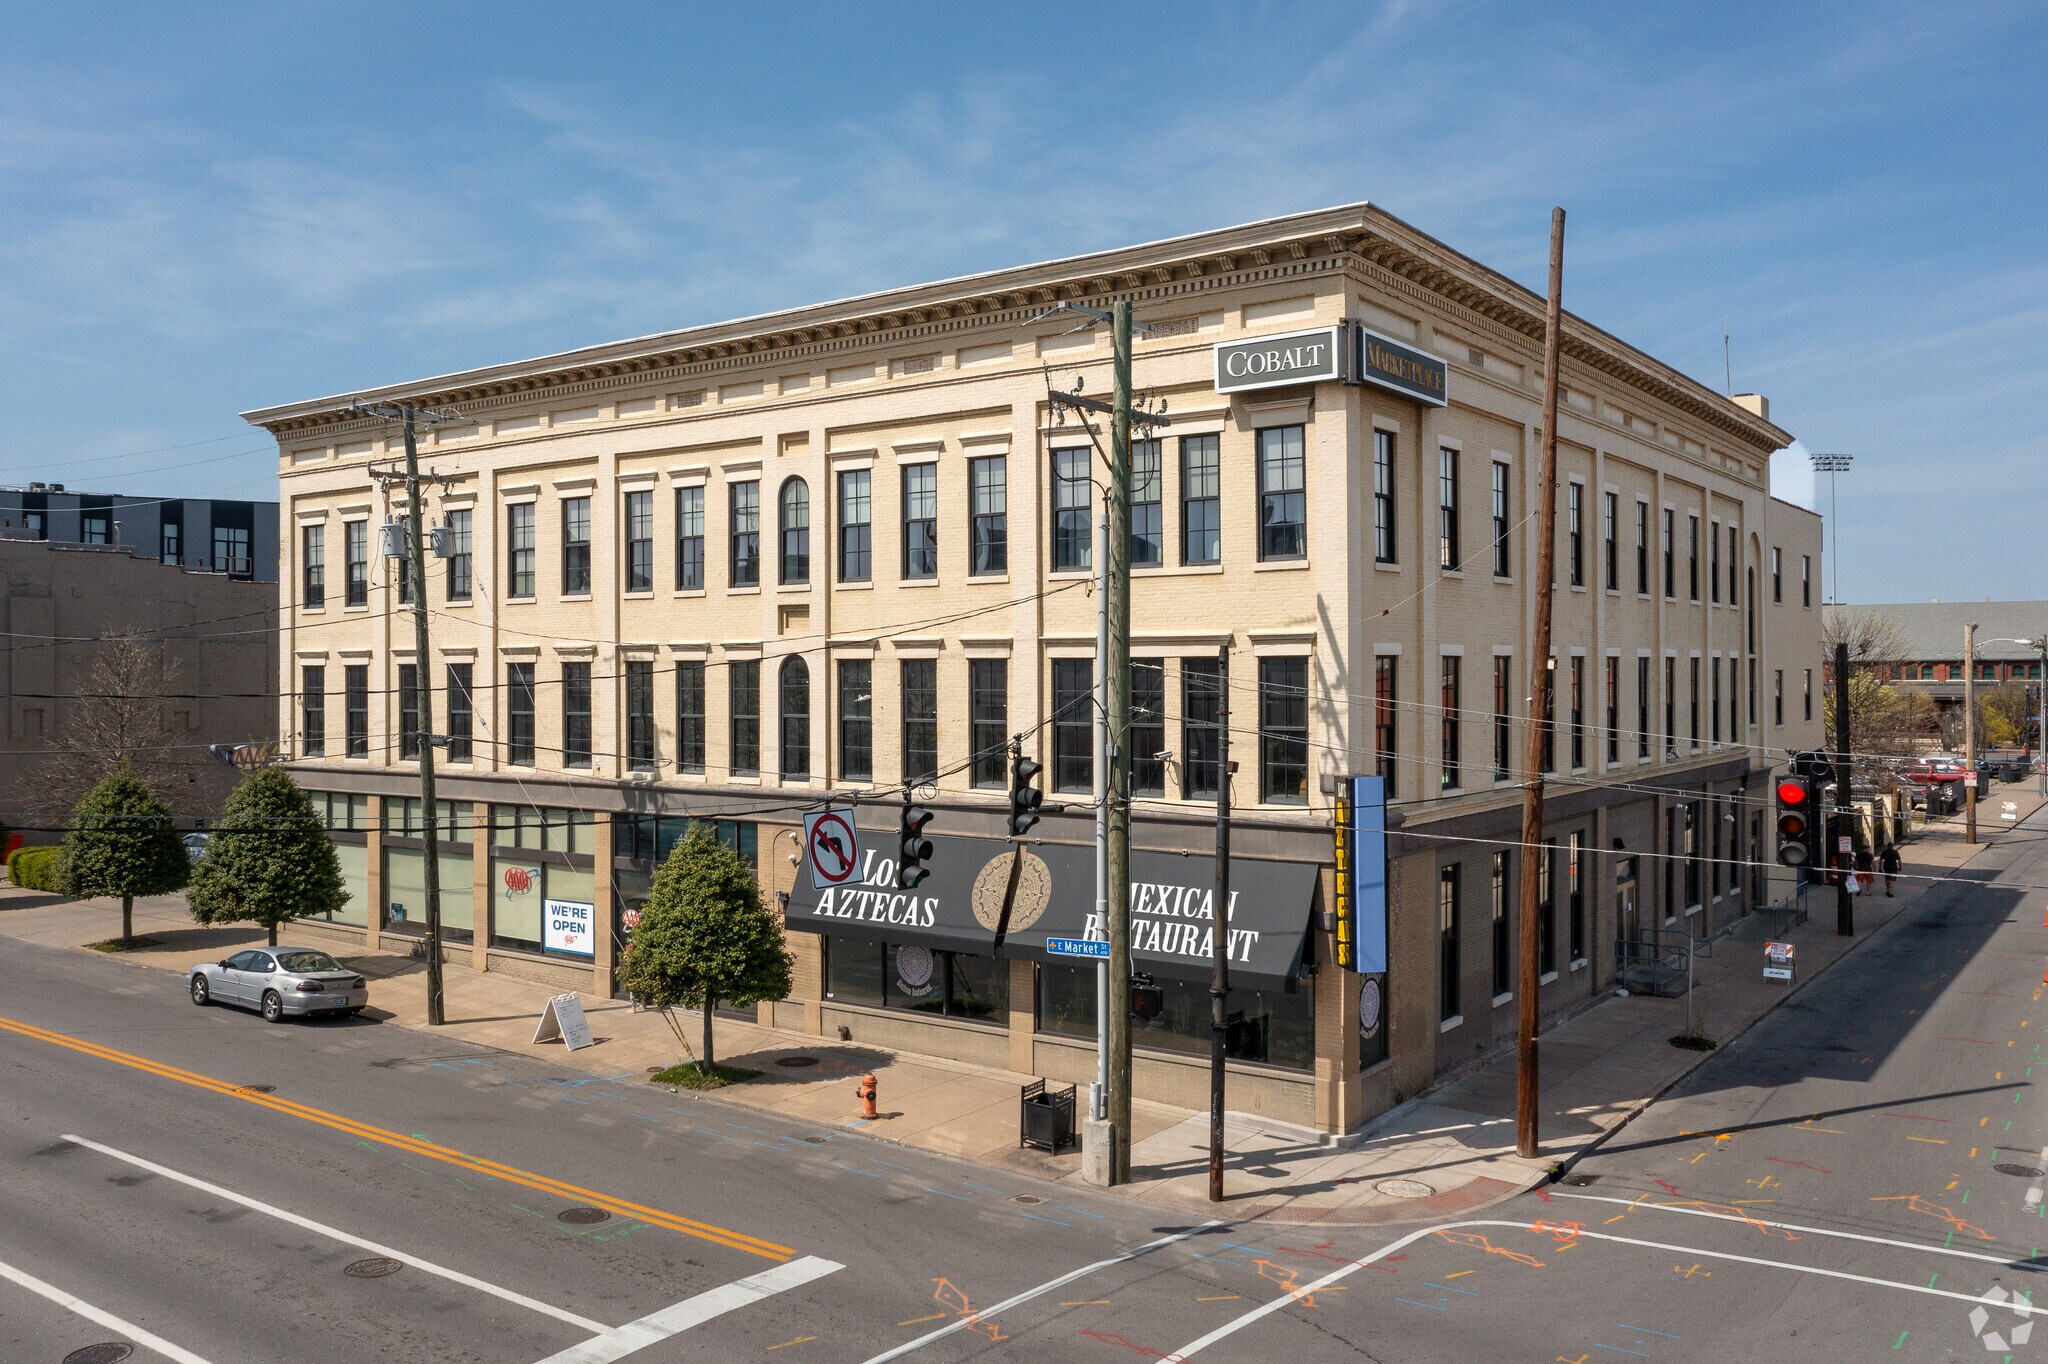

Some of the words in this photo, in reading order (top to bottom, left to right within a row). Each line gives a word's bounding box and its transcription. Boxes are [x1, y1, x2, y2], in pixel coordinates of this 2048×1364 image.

[1226, 344, 1325, 377] COBALT
[861, 849, 900, 888] LO
[1336, 801, 1350, 966] AZTECAS
[551, 904, 588, 919] WE'RE
[813, 887, 939, 927] AZTECAS
[553, 919, 586, 934] OPEN
[1083, 913, 1259, 962] RTAURAT
[1057, 942, 1063, 950] E
[1064, 941, 1098, 954] Market
